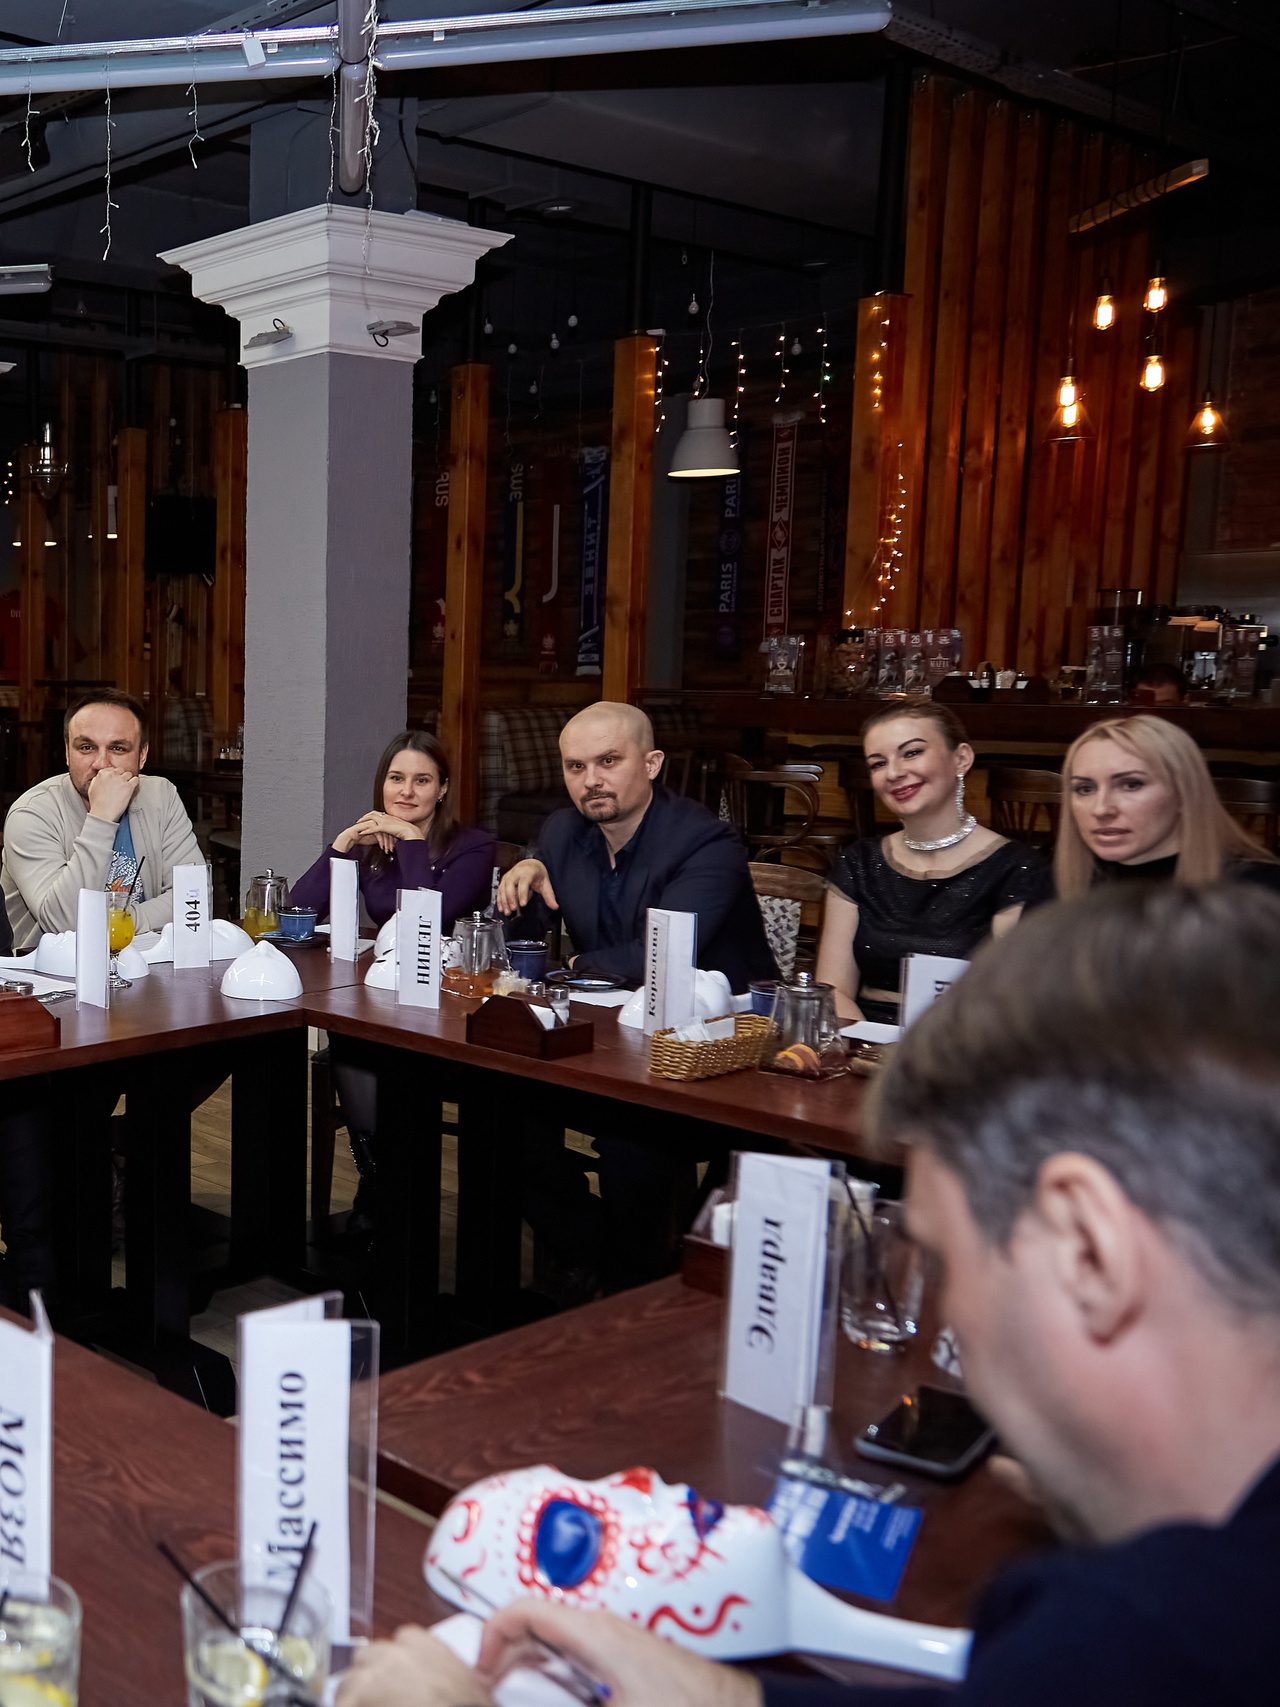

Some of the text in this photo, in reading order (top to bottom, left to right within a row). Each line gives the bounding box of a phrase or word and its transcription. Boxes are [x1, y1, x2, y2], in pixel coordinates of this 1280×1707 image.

[434, 471, 449, 508] RUS
[509, 463, 524, 503] SWE
[724, 478, 737, 519] PARI
[584, 516, 597, 595] ЗЕНИТ
[770, 445, 791, 617] СПАРТАК ЧЕМПИОН
[718, 562, 733, 613] PARIS
[417, 915, 432, 986] ЛЕНИН
[647, 925, 659, 1018] Королева
[744, 1214, 787, 1353] Эдвард
[265, 1370, 309, 1583] Массимо
